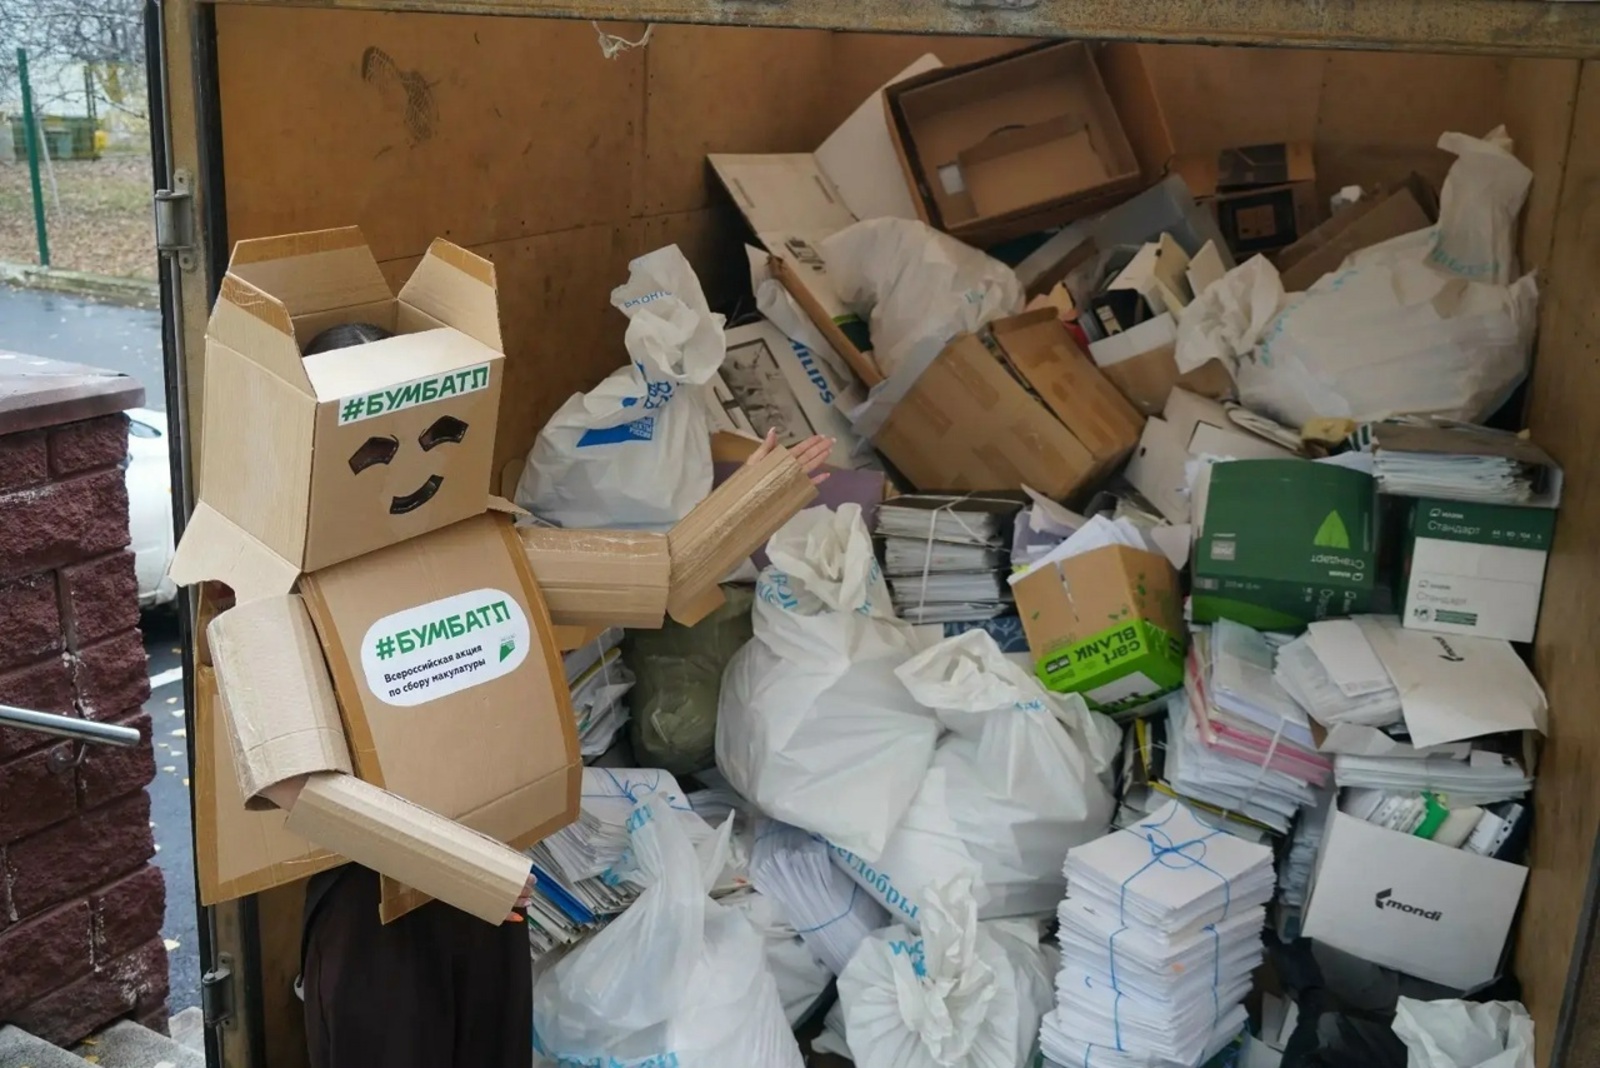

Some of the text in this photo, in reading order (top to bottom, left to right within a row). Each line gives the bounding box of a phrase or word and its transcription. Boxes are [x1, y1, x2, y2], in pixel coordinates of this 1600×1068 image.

[788, 337, 836, 404] ILIPS
[341, 366, 488, 421] #БУМБАТЛ
[1427, 521, 1480, 535] Стандарт
[375, 600, 511, 660] #БУМБАТЛ
[1074, 625, 1137, 662] BLANK
[384, 644, 482, 683] Всероссийская акция
[1103, 640, 1141, 664] cart
[388, 658, 486, 698] по сбору макулатуры
[1385, 899, 1442, 921] mondi
